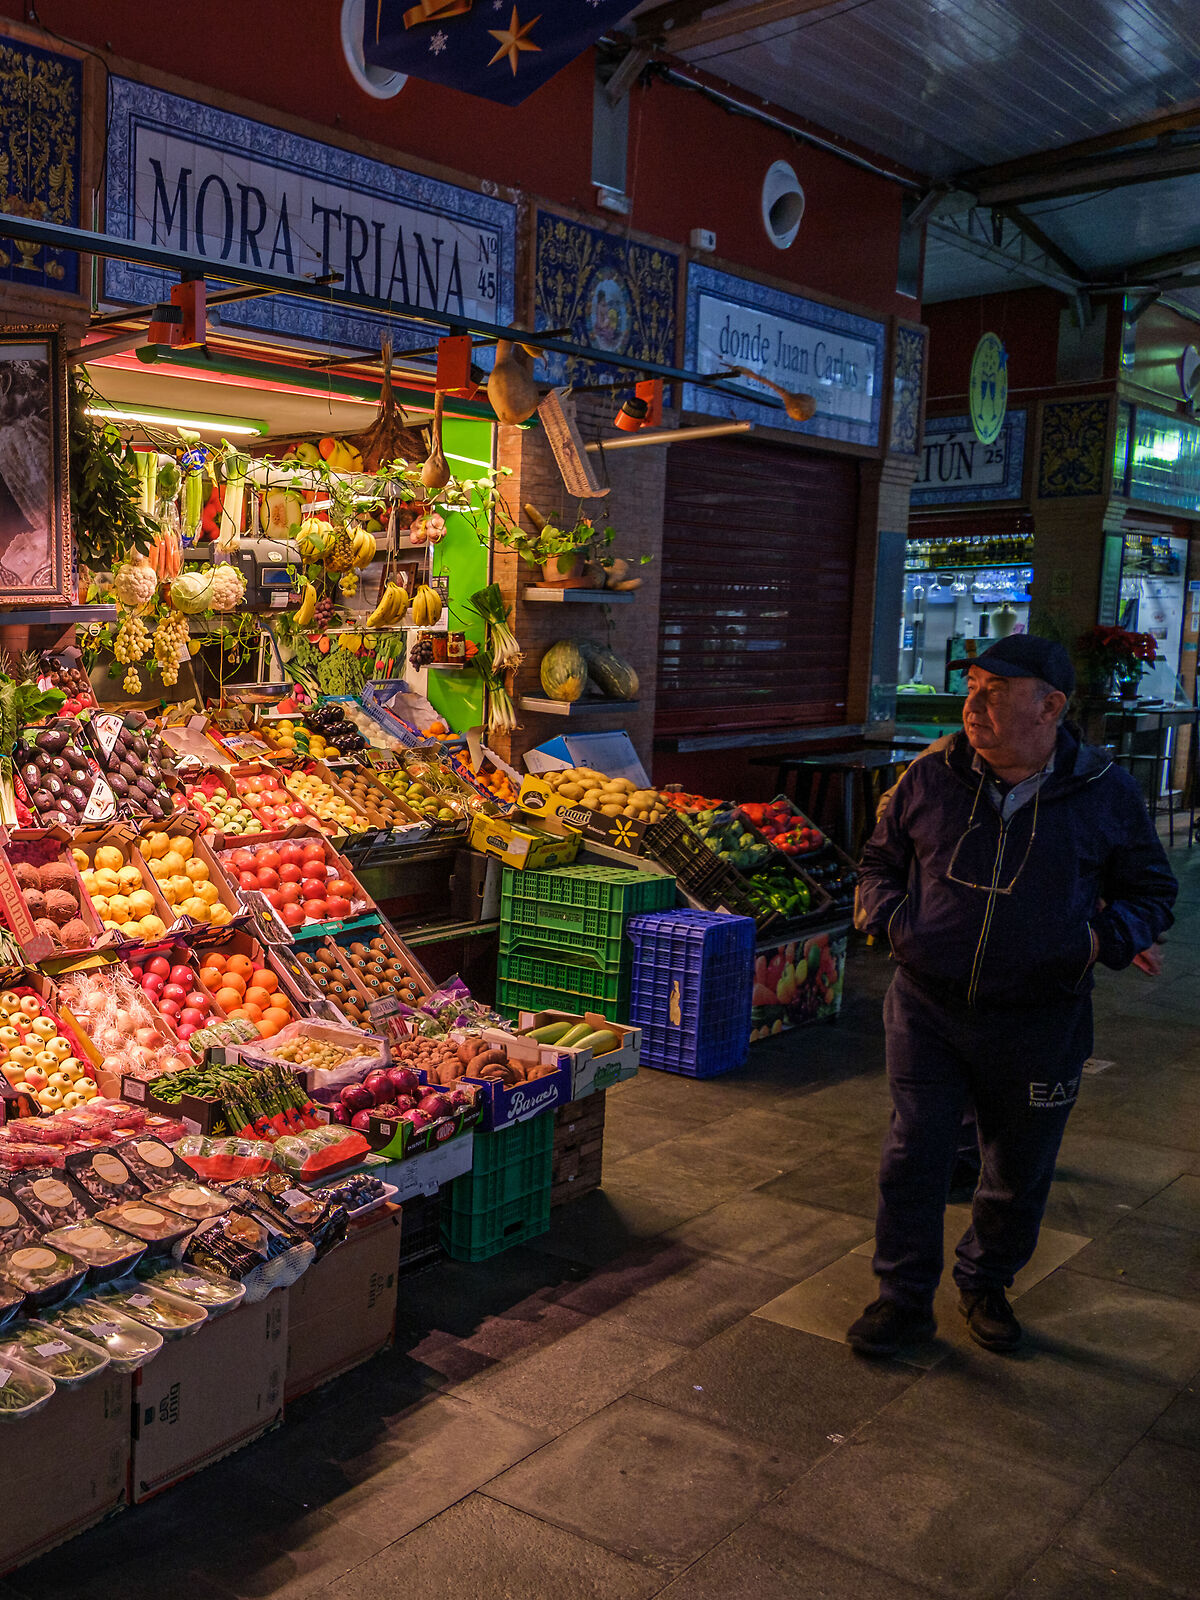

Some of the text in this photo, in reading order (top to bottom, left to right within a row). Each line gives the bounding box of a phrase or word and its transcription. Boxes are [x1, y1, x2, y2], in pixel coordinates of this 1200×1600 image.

[149, 157, 295, 275] MORA
[311, 197, 465, 318] TRIANA
[478, 268, 497, 301] 45
[719, 315, 858, 387] donde Juan Carlos
[914, 433, 977, 483] TÚN
[985, 448, 1004, 465] 25
[555, 805, 592, 823] Cuqui
[0, 880, 31, 939] palma
